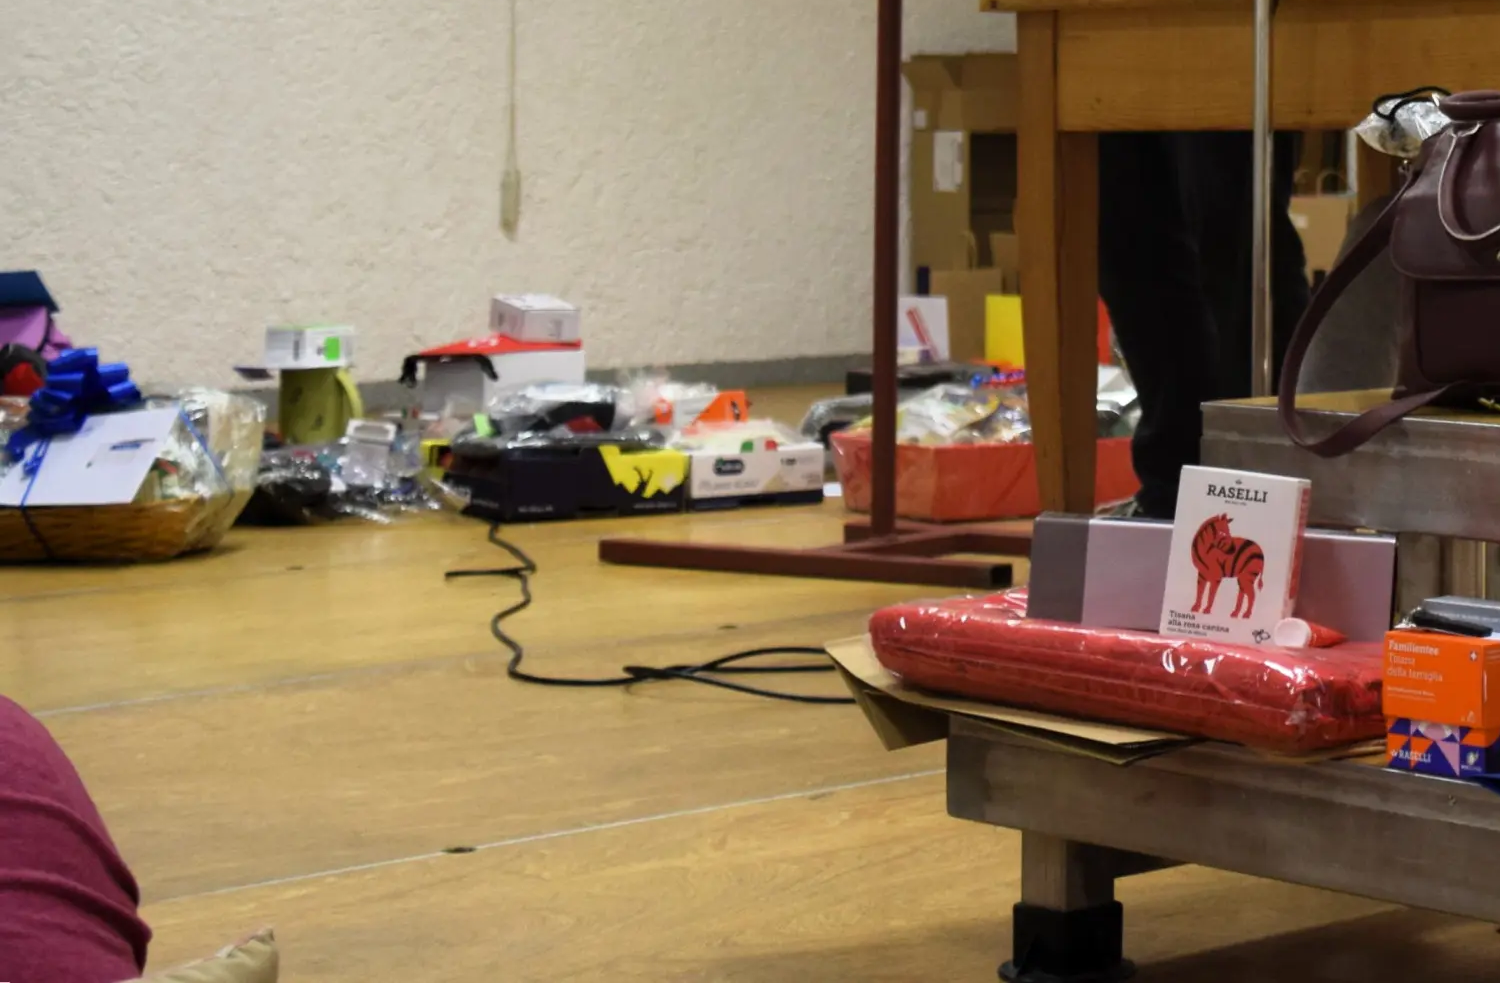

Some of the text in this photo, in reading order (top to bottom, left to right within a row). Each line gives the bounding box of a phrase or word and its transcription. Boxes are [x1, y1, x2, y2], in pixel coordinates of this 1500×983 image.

[1206, 484, 1268, 504] RASELLI
[1170, 610, 1196, 620] Tisana
[1168, 619, 1230, 634] alla rosa canina
[1388, 639, 1440, 656] Familientee
[1399, 750, 1431, 763] RASELLI
